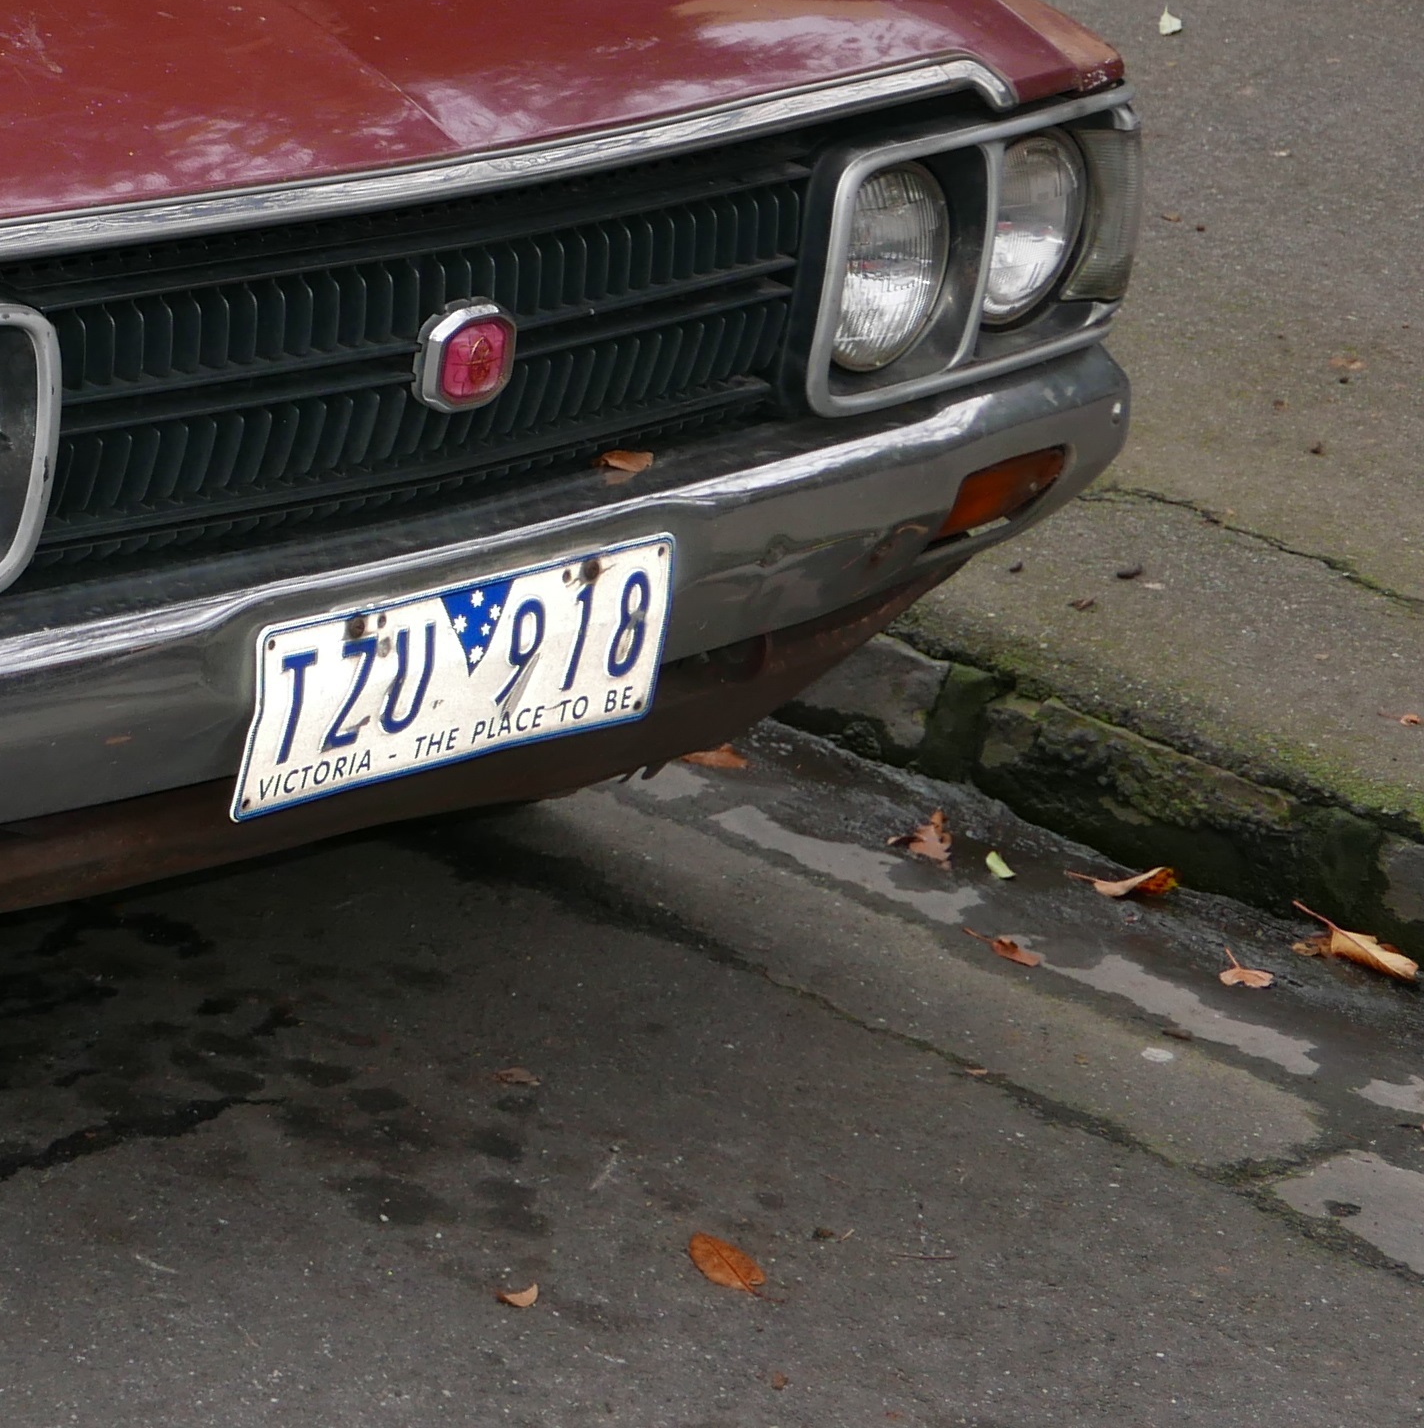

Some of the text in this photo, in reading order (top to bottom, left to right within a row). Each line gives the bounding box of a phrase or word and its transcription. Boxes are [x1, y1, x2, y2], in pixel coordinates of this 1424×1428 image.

[258, 749, 372, 802] VICTORIA
[414, 726, 460, 760] THE
[471, 705, 546, 745] PLACE
[558, 694, 589, 722] TO
[604, 686, 634, 713] BE
[277, 570, 651, 765] TZU 918
